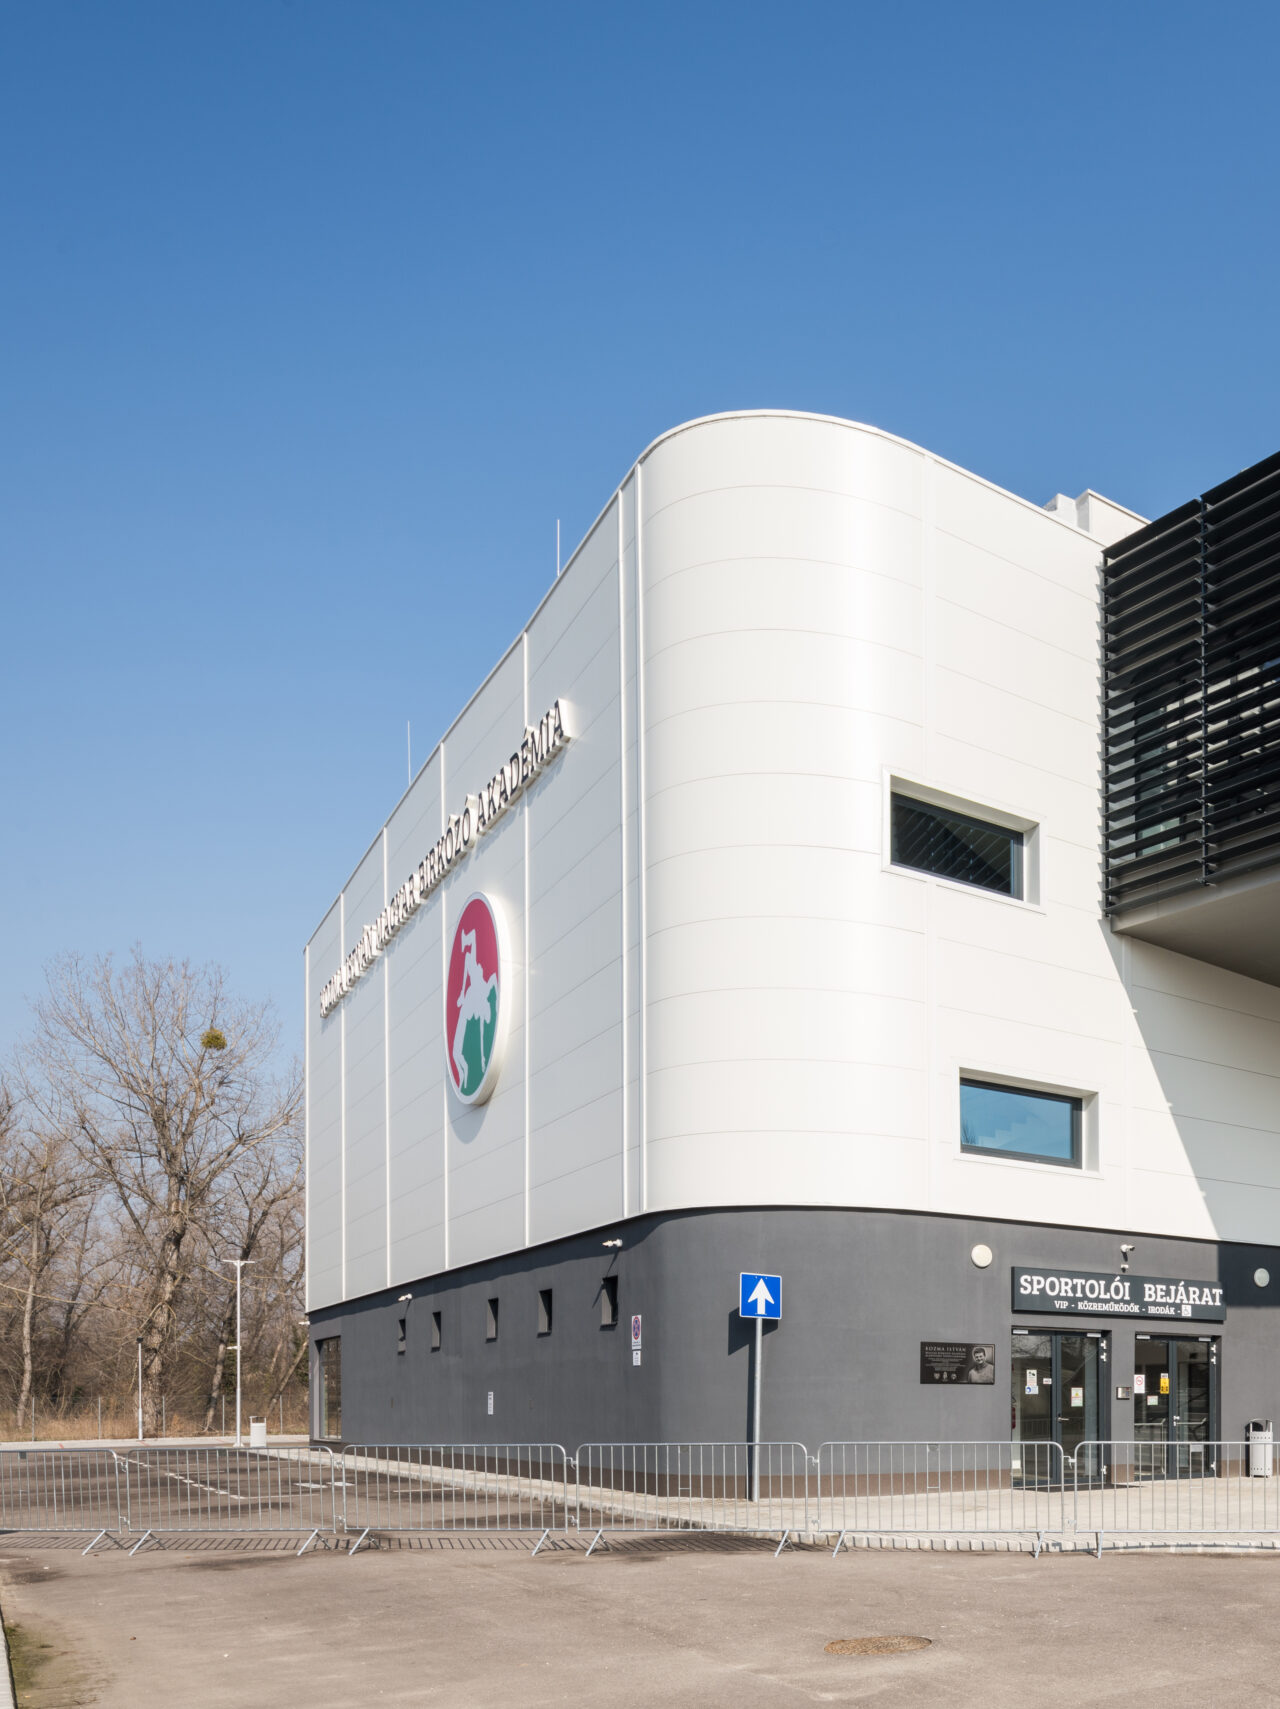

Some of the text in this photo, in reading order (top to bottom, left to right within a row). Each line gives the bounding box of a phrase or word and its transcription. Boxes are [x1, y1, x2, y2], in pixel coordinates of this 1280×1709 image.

[376, 873, 417, 950] MAGYAR
[419, 794, 473, 898] BIRKÓZÓ
[476, 699, 565, 835] AKADÉMIA
[1019, 1275, 1224, 1306] SPORTOLÓI BEJÁRAT
[1054, 1300, 1069, 1309] VIP
[1077, 1300, 1140, 1313] KÖZREMŰKÖDŐK
[1147, 1304, 1175, 1315] IRODÁK
